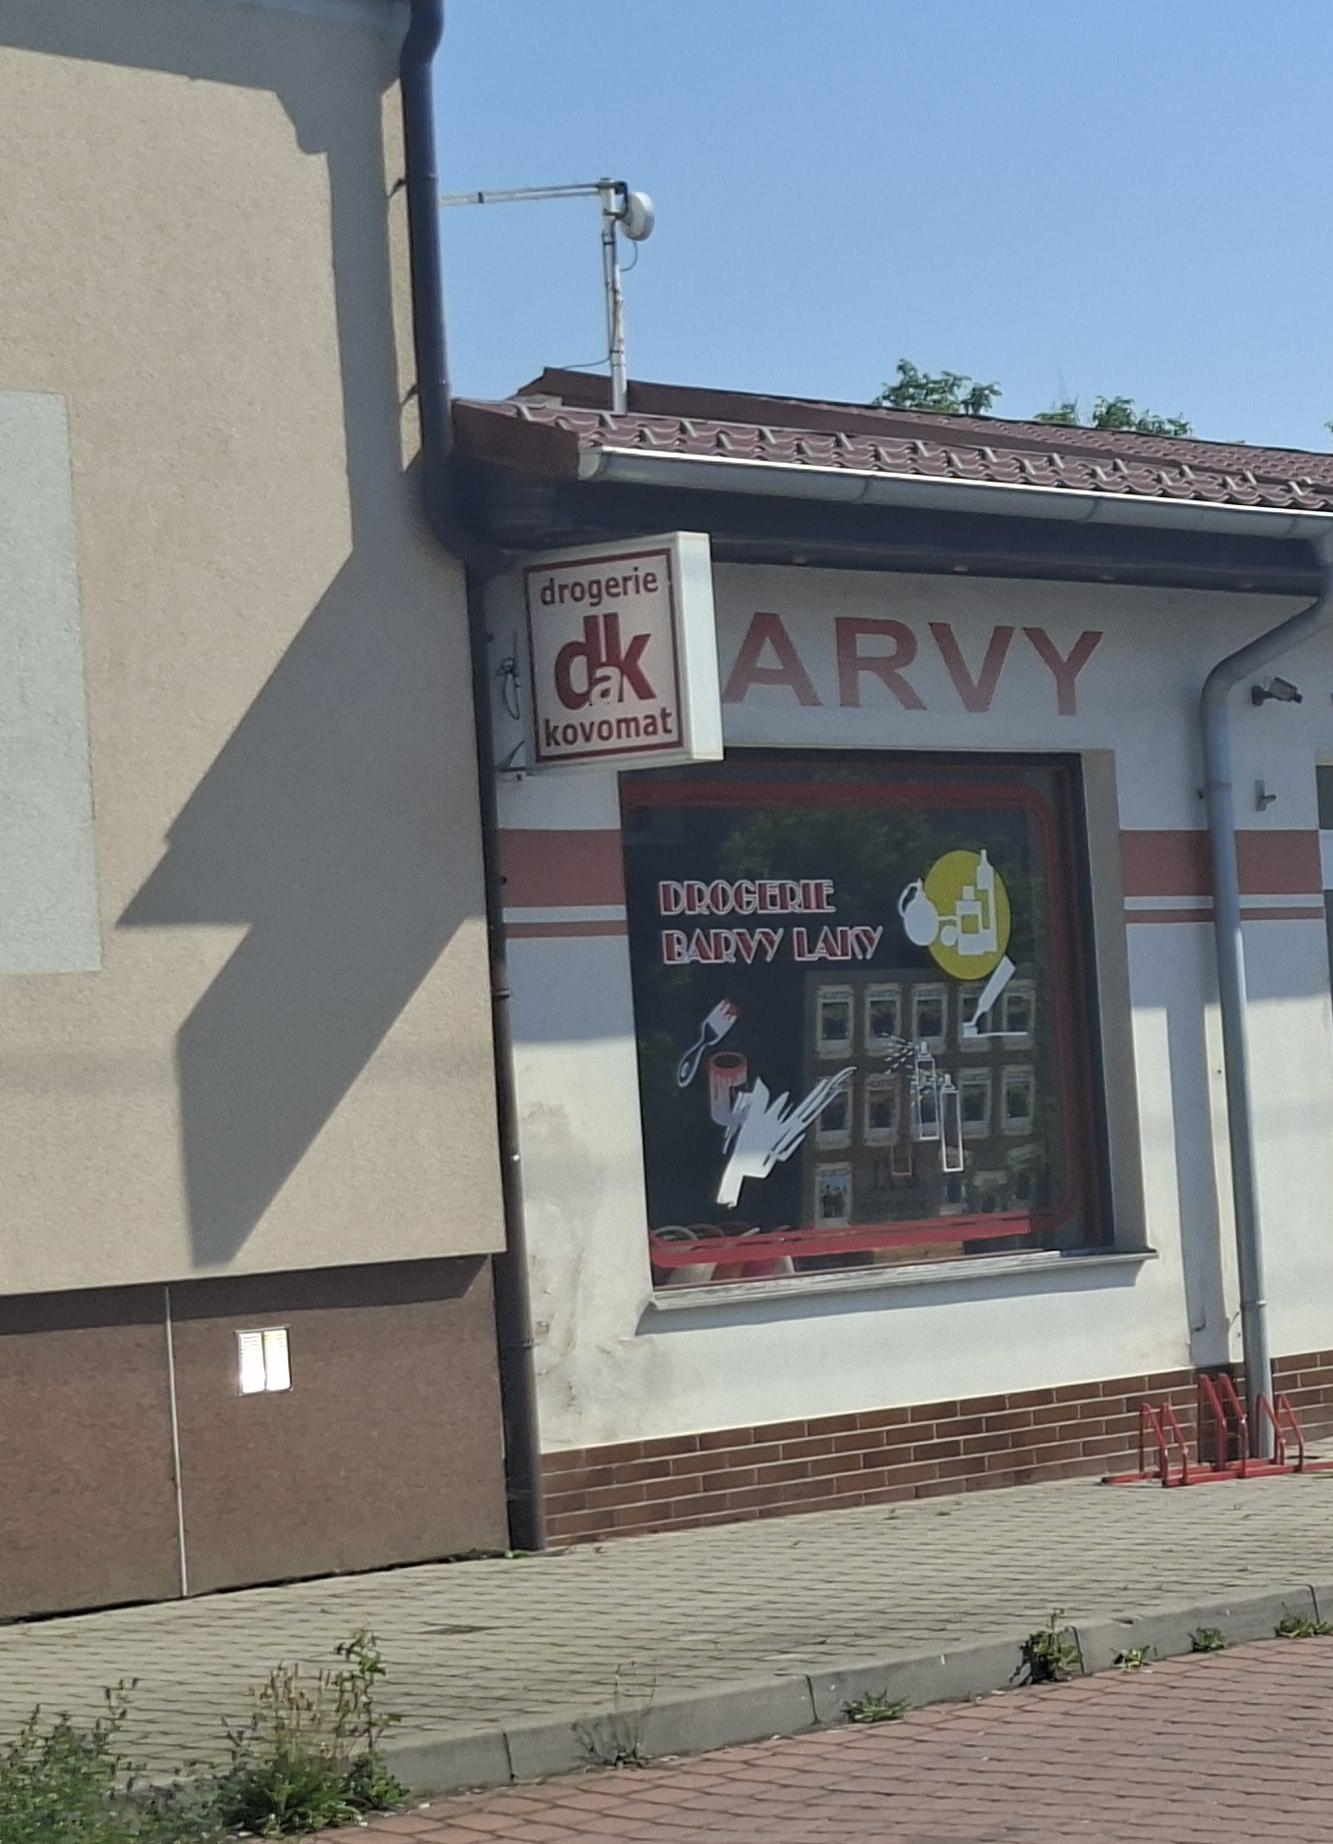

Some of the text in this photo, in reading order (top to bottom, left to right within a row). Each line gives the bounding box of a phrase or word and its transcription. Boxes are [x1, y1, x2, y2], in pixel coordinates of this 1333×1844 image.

[540, 567, 659, 607] drogerie
[721, 611, 1104, 716] ARVY
[543, 707, 673, 747] kovomat
[658, 879, 837, 916] DROGERIE
[662, 925, 884, 964] BARVY LAKY
